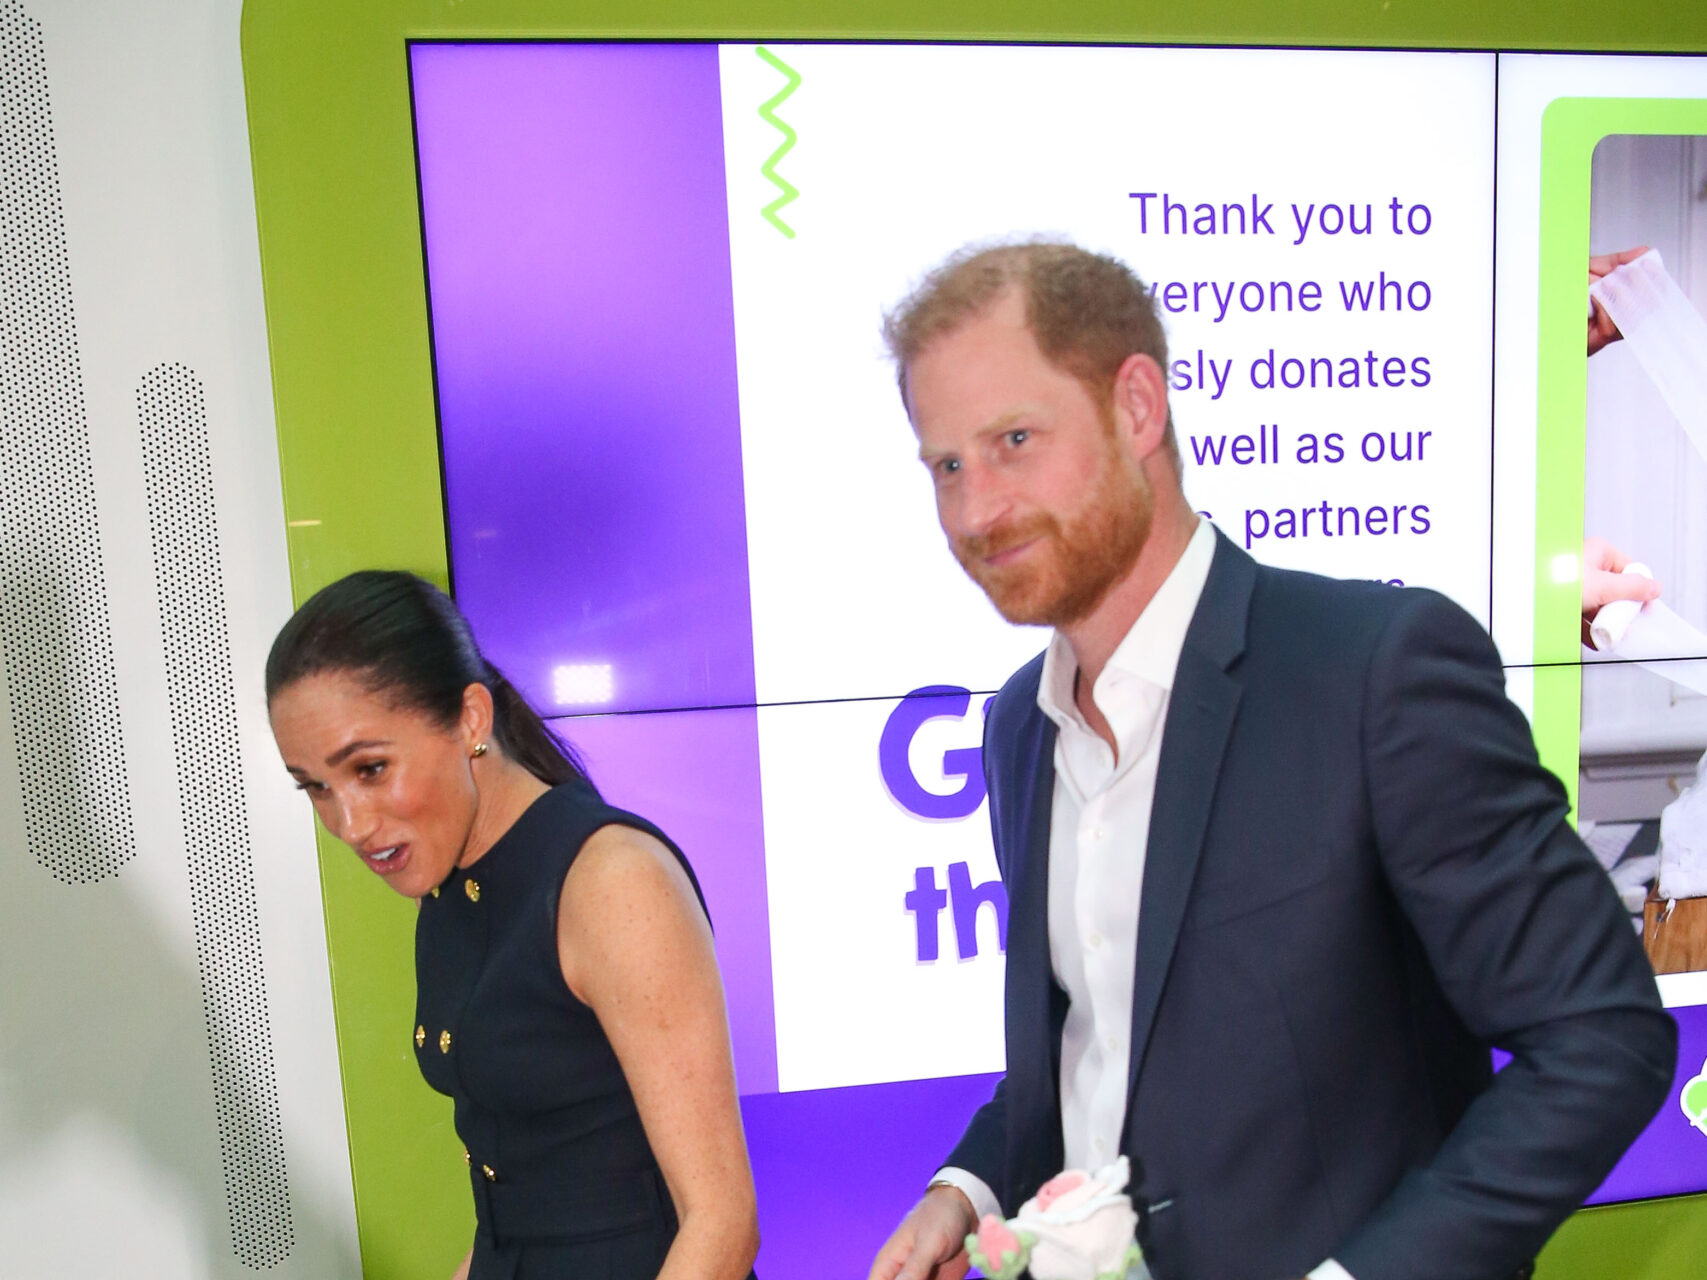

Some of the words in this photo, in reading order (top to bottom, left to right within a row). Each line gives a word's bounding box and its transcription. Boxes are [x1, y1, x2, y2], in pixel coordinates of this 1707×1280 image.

[1128, 192, 1275, 235] Thank
[1291, 203, 1373, 246] you
[1389, 196, 1432, 236] to
[1338, 271, 1432, 312] who
[1249, 349, 1431, 389] donates
[1190, 424, 1279, 466] well
[1295, 432, 1346, 464] as
[1360, 431, 1432, 462] our
[1244, 500, 1431, 549] partners
